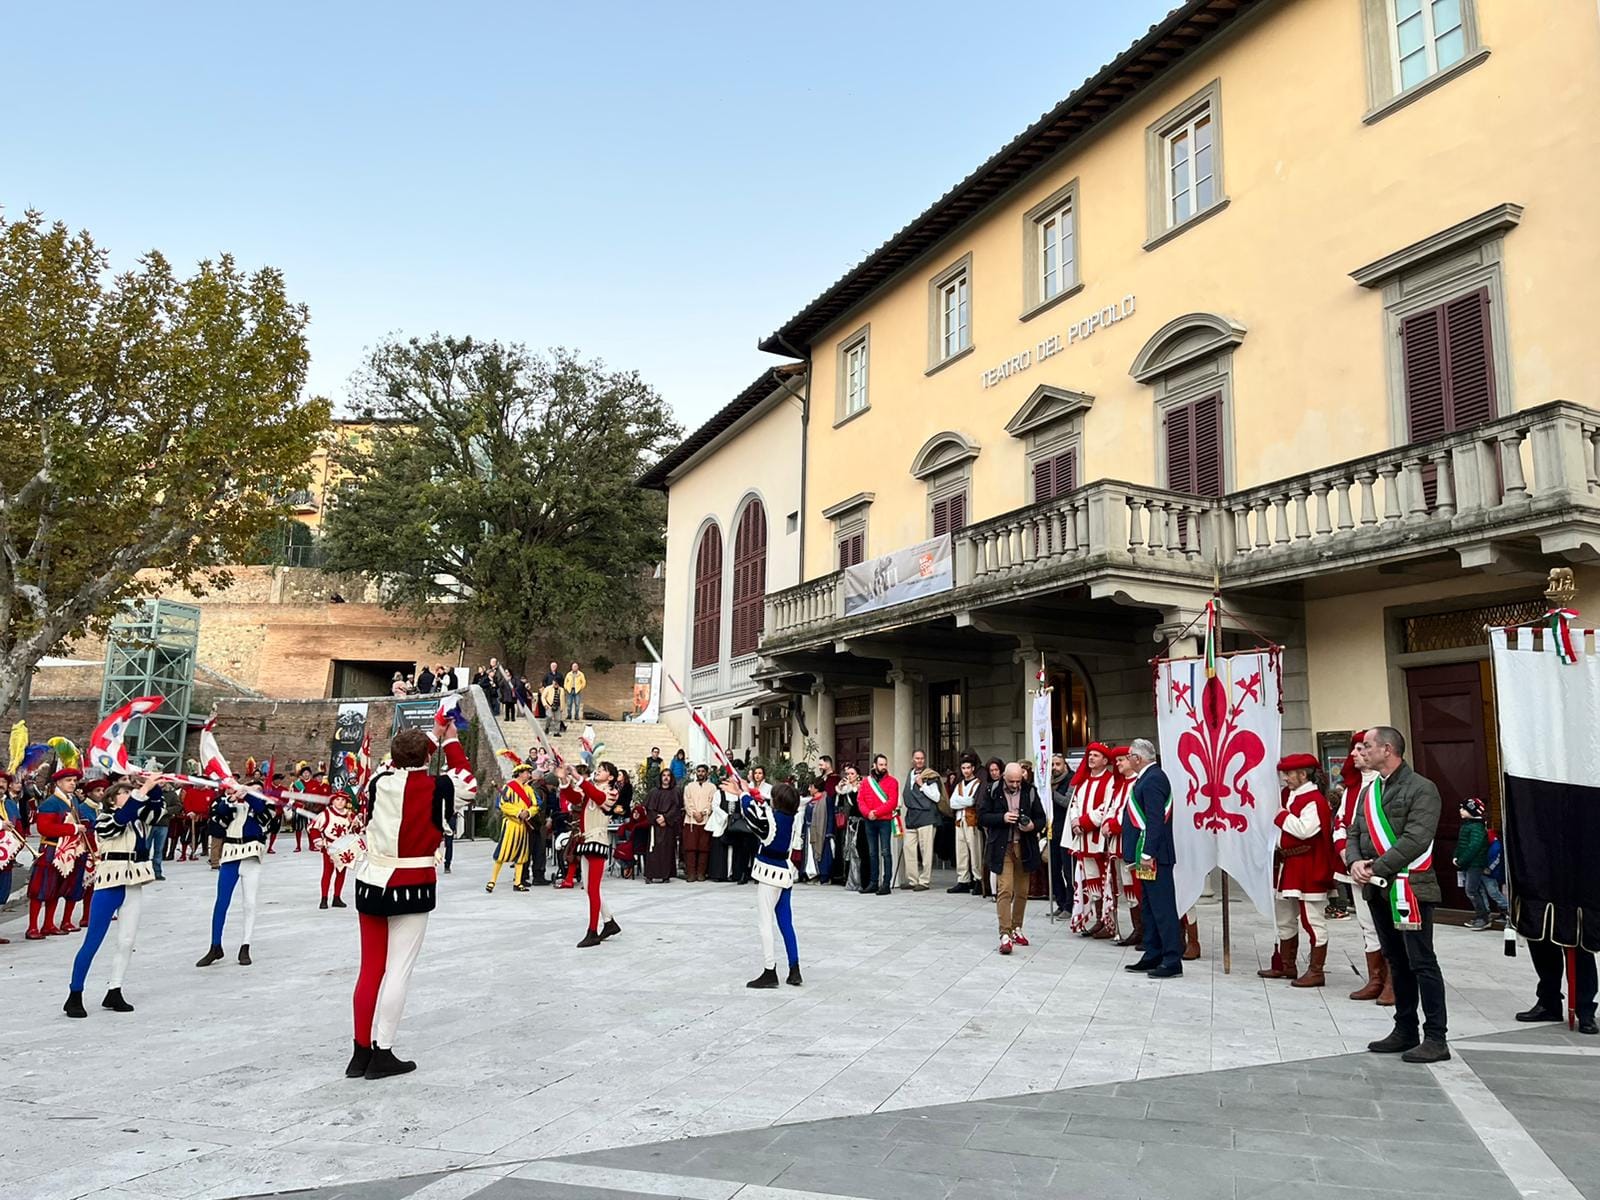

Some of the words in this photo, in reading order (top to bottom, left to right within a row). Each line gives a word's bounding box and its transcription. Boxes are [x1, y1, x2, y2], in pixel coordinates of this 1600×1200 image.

[981, 350, 1031, 388] TEATRO
[1036, 334, 1064, 362] DEL
[1068, 294, 1135, 343] POPOLO
